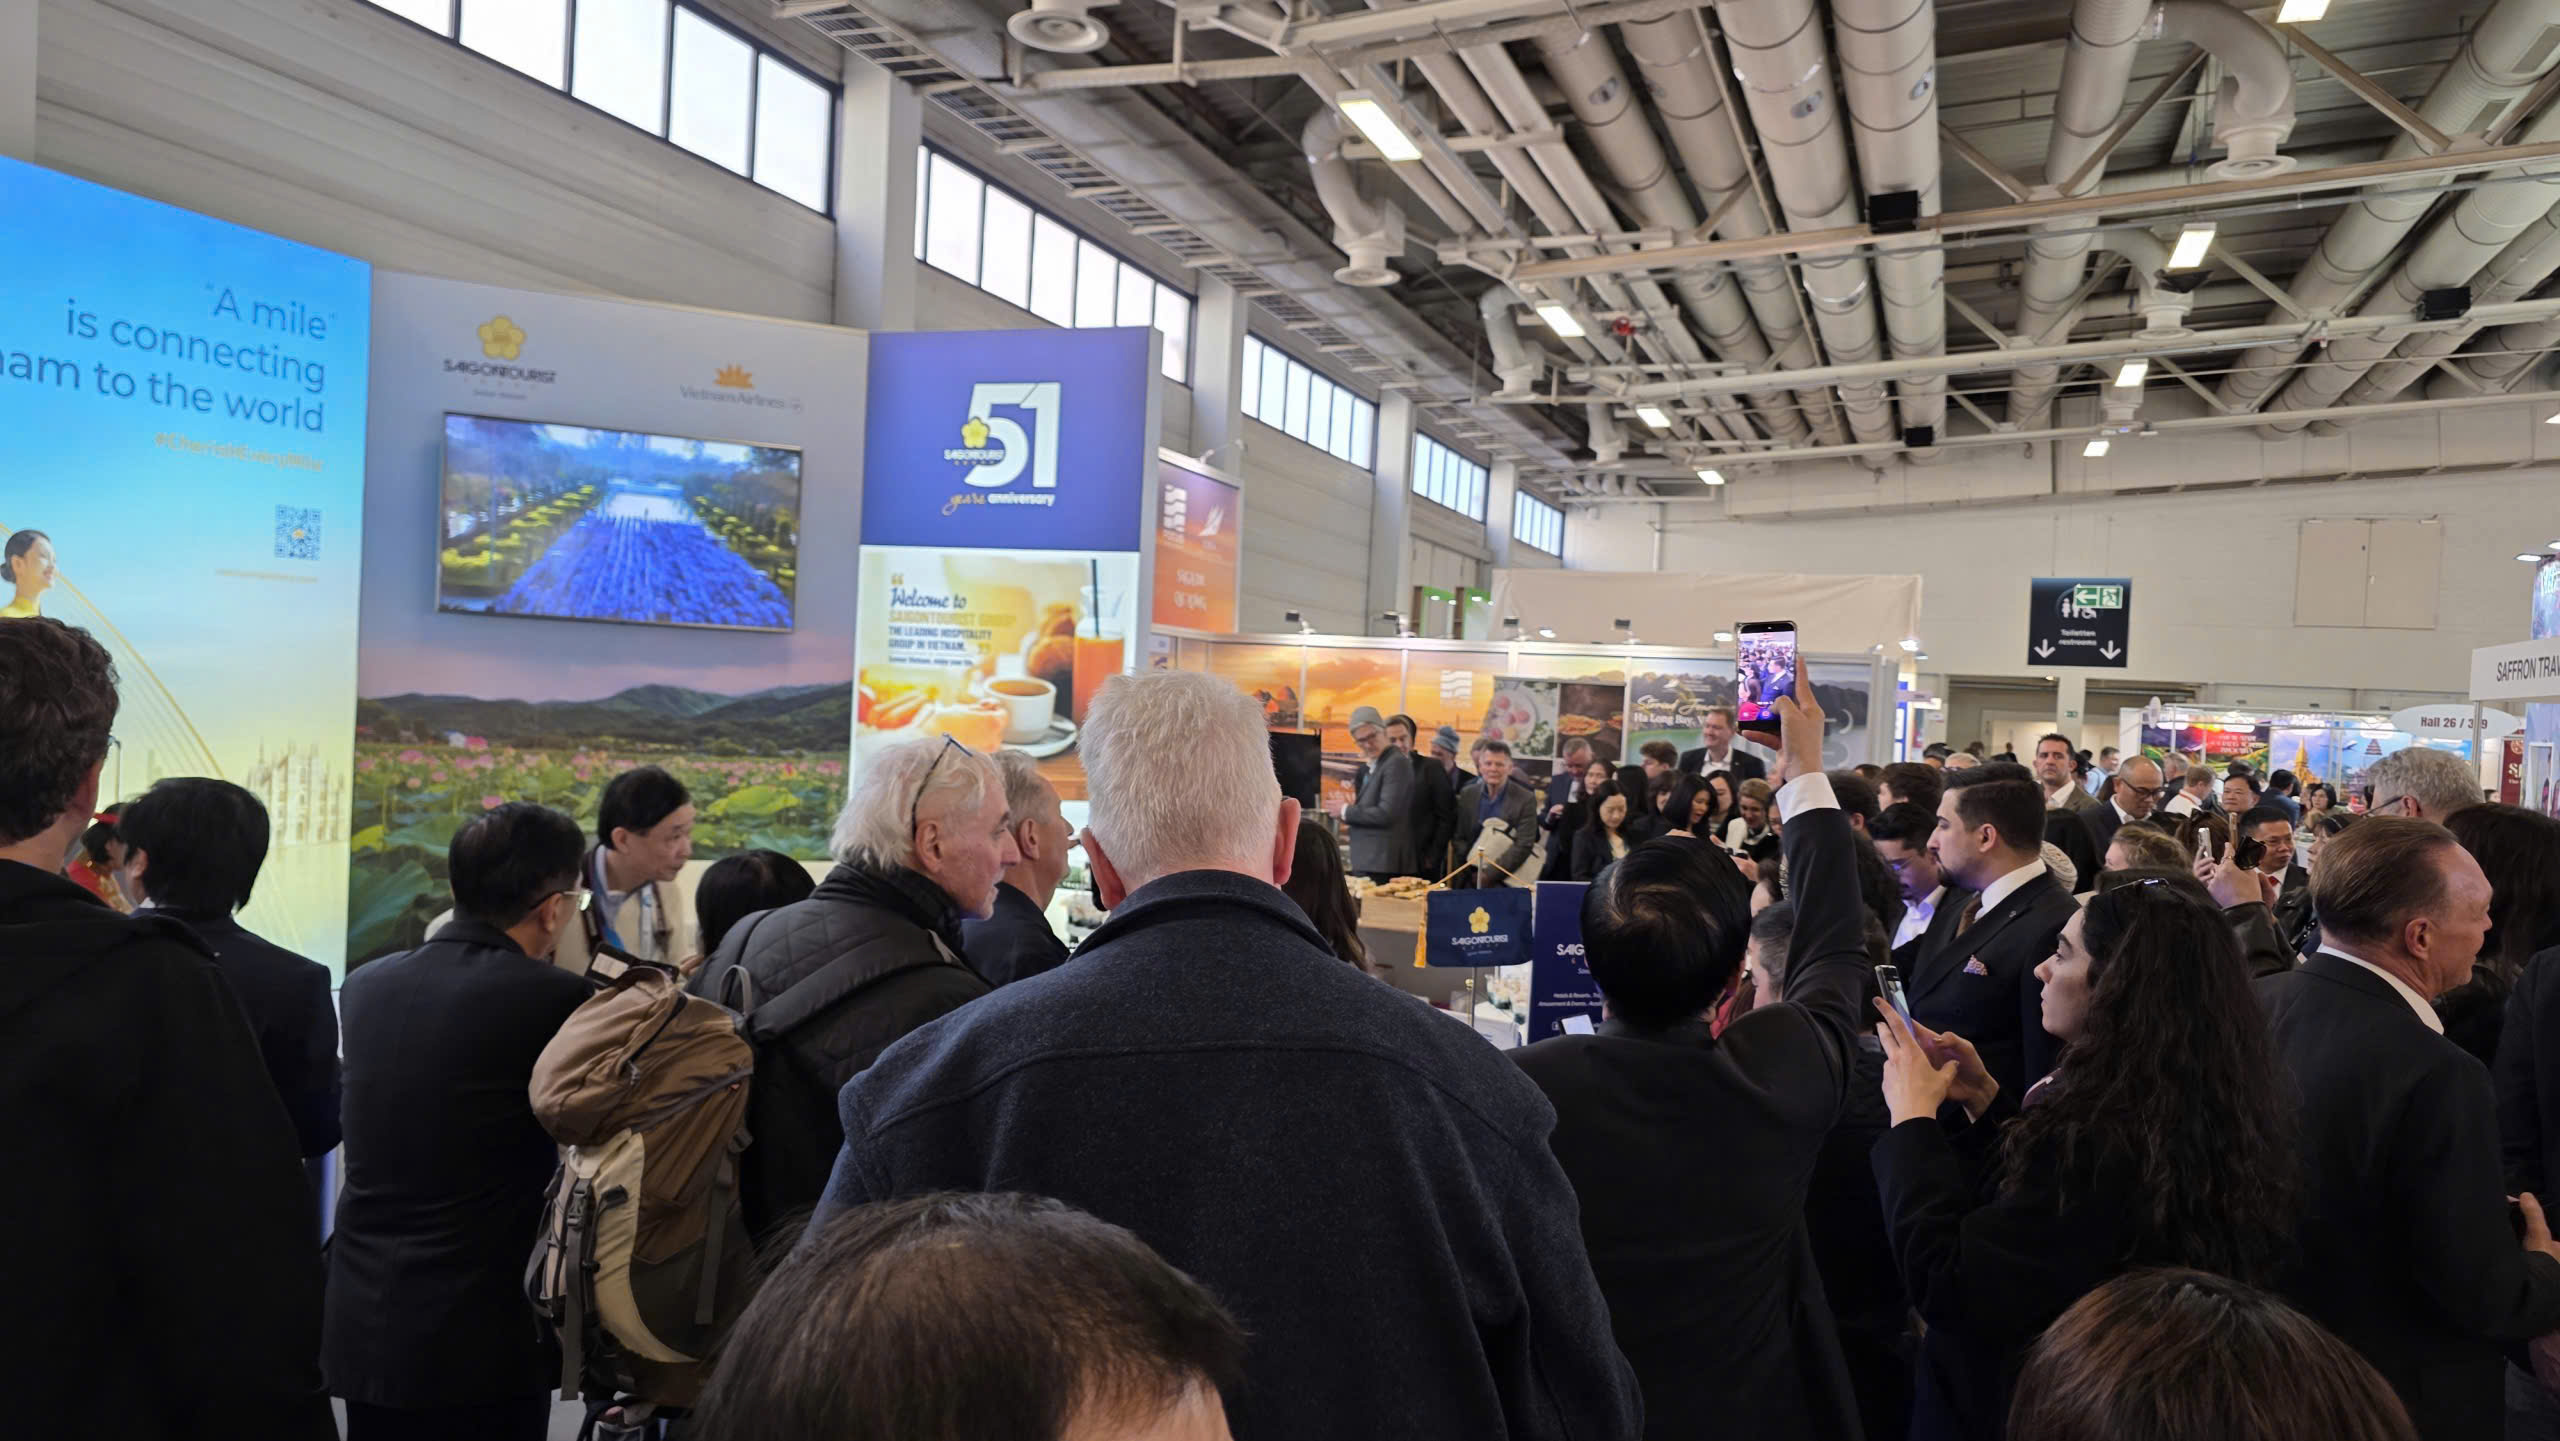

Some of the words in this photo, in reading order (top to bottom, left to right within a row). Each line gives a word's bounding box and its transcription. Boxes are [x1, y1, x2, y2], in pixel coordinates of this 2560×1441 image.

[66, 298, 98, 338] is
[110, 318, 325, 394] connecting
[94, 360, 136, 398] to
[147, 372, 214, 414] the
[223, 393, 324, 433] world
[965, 382, 1062, 488] 51
[987, 491, 1056, 507] anniversary
[890, 587, 950, 608] Welcome
[953, 594, 967, 609] to
[888, 626, 902, 636] THE
[904, 627, 939, 638] LEADING
[941, 628, 993, 640] HOSPITALITY
[2060, 629, 2096, 637] Toiletten
[888, 639, 915, 649] GROUP
[917, 640, 925, 649] IN
[2496, 658, 2537, 682] SAFFRON
[2420, 716, 2440, 728] Hall
[2443, 717, 2457, 729] 26
[2459, 718, 2465, 728] /
[2467, 718, 2488, 729] 39
[1556, 943, 1585, 956] SAIG
